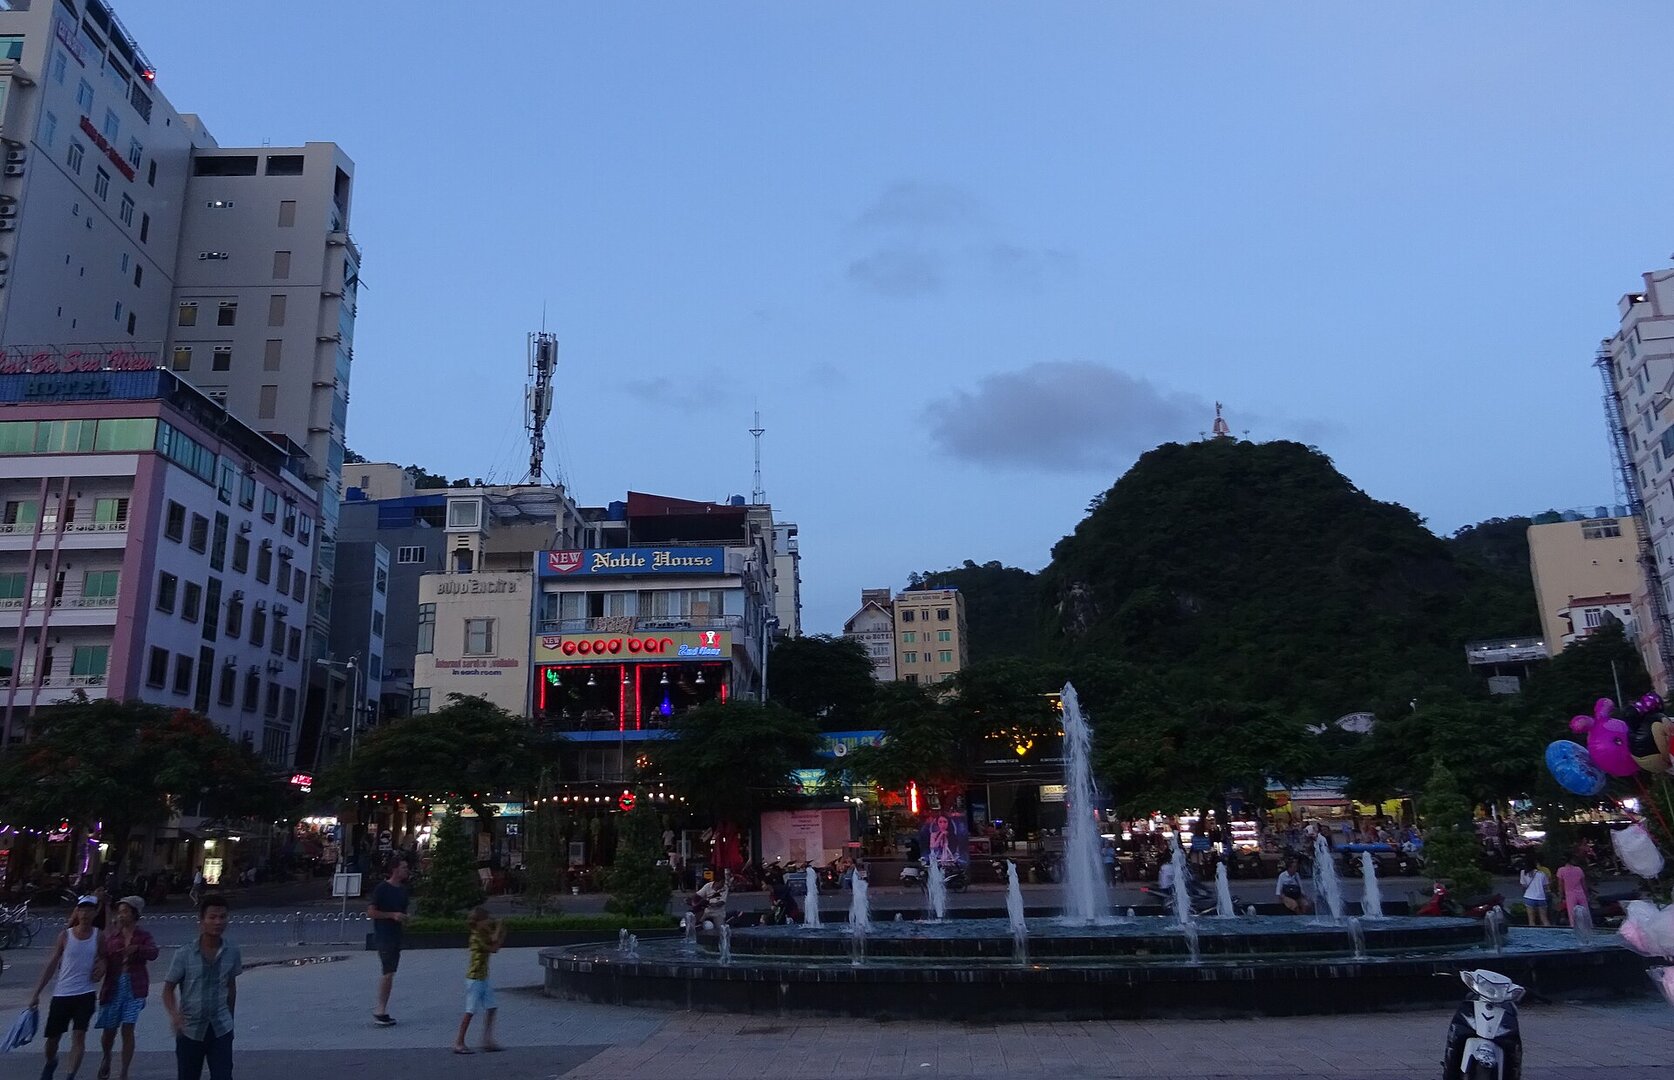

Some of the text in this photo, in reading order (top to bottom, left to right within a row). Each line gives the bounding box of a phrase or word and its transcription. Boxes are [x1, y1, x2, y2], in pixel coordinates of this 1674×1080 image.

[25, 379, 110, 397] HOTEL
[549, 552, 581, 563] NEW
[592, 551, 713, 572] Noble House
[543, 637, 562, 649] NEW
